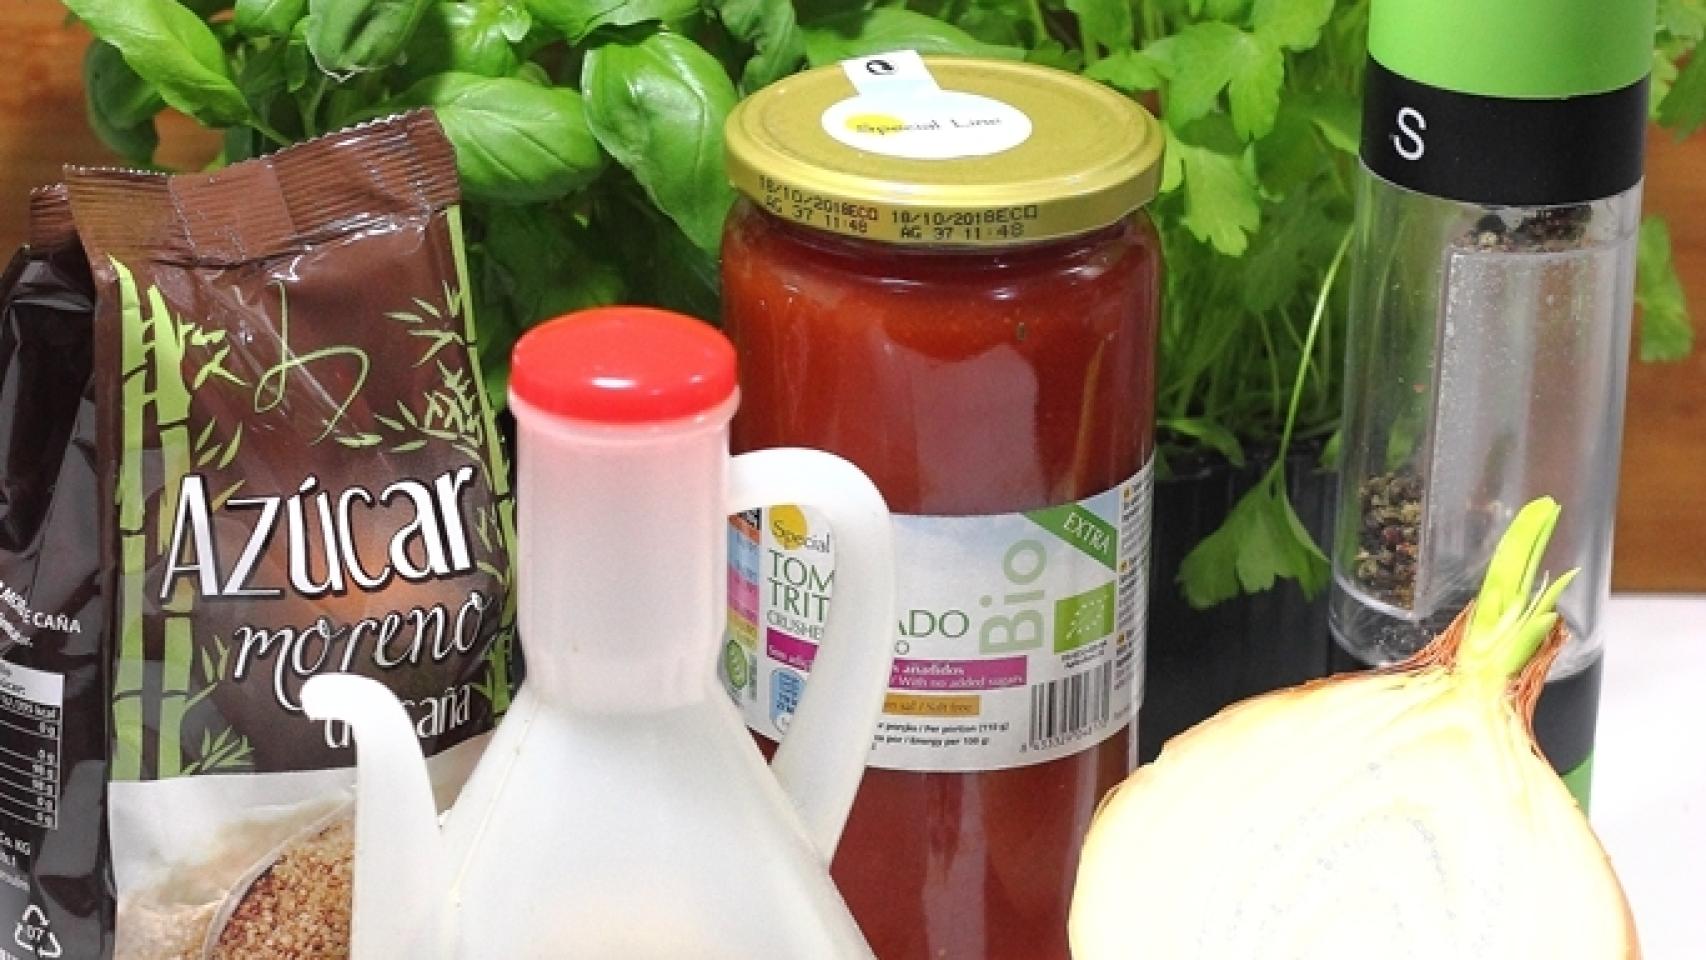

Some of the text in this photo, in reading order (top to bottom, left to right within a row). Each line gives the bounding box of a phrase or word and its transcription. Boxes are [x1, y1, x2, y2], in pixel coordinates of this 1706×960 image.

[1393, 106, 1427, 161] S
[792, 204, 814, 222] 37
[901, 228, 923, 240] AG
[933, 227, 954, 240] 37
[159, 465, 474, 601] Azúcar
[772, 519, 831, 554] Special
[1060, 511, 1111, 557] EXTRA
[978, 538, 1047, 654] Bio
[34, 612, 81, 634] CAÑA
[234, 590, 486, 712] moreno
[949, 676, 985, 688] added
[941, 725, 978, 735] portion
[943, 738, 960, 748] per
